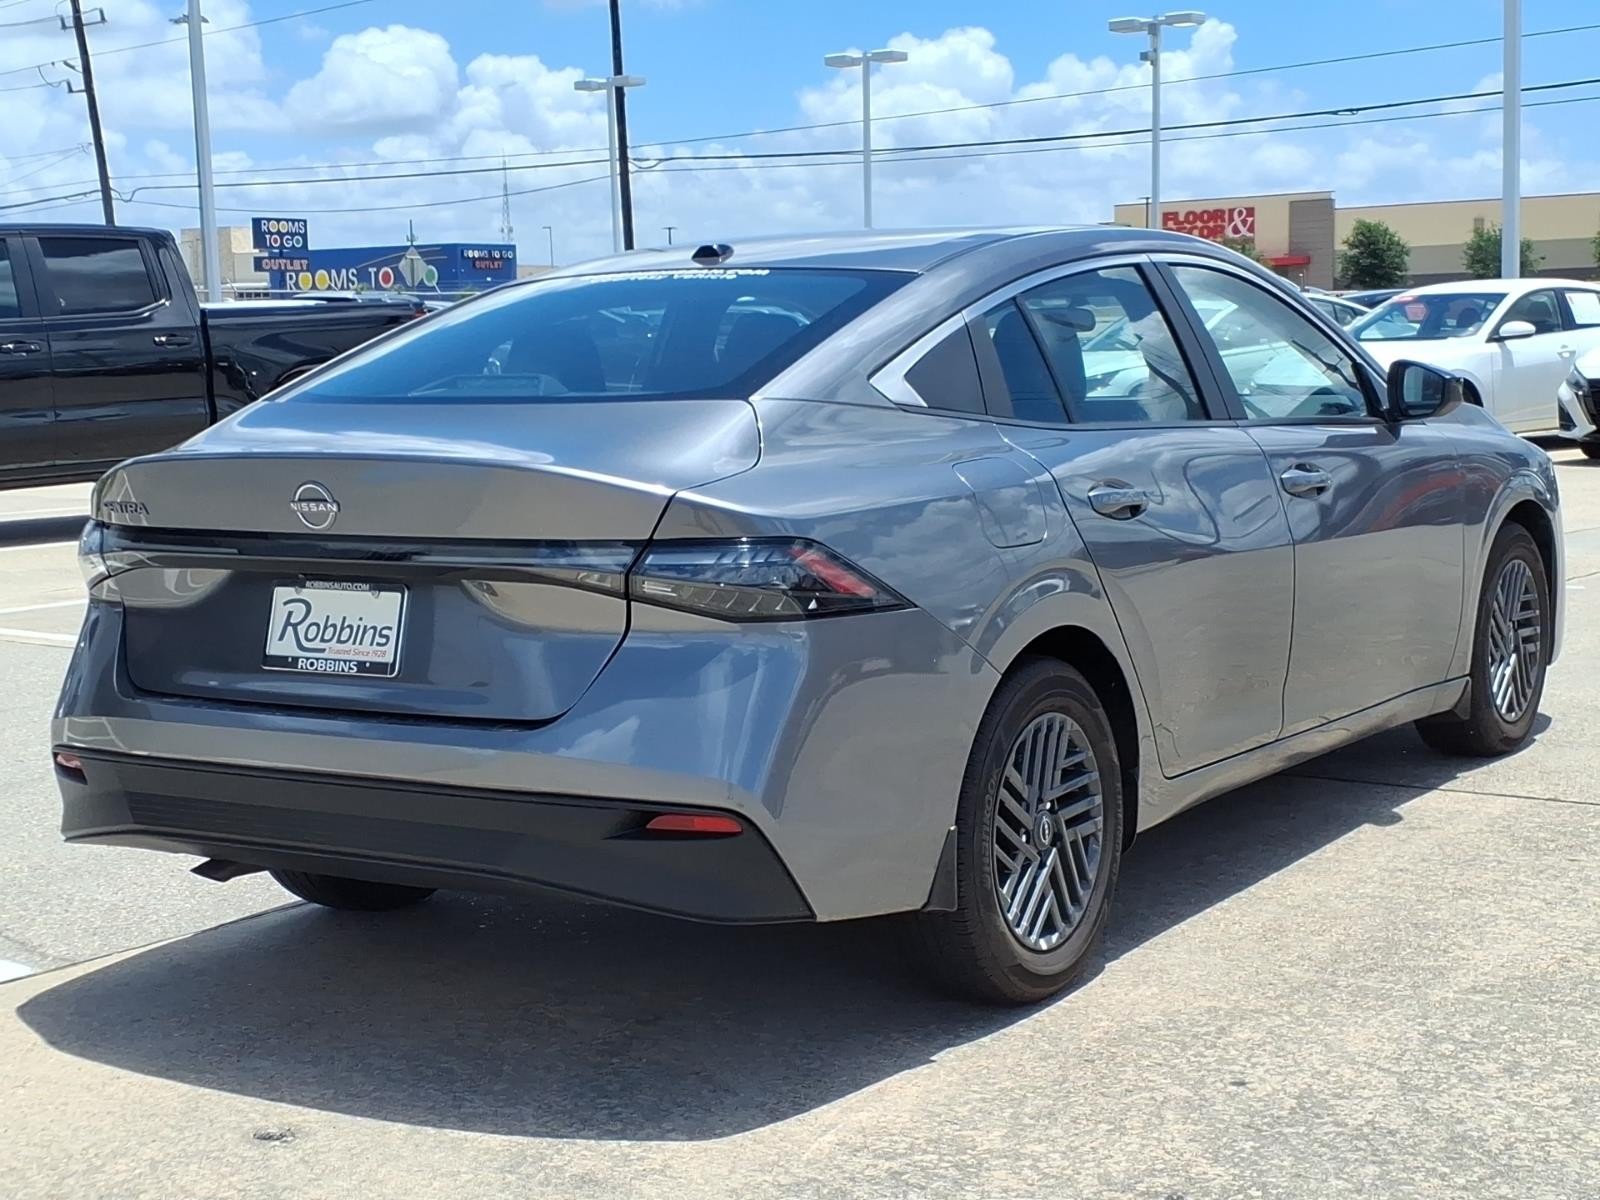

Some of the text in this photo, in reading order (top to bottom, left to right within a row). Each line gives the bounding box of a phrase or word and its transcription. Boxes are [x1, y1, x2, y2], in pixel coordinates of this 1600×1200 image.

[261, 219, 305, 233] ROOMS
[1162, 207, 1254, 237] FLOOR &
[265, 234, 303, 247] TO GO
[463, 249, 489, 258] ROOMS
[502, 250, 514, 259] GO
[262, 259, 308, 271] OUTLET
[474, 260, 503, 269] OUTLET
[286, 267, 359, 292] ROOMS
[368, 266, 394, 289] TO
[290, 502, 338, 512] NISSAN
[278, 597, 393, 653] Robbins
[352, 649, 370, 657] Since
[297, 657, 358, 673] ROBBINS
